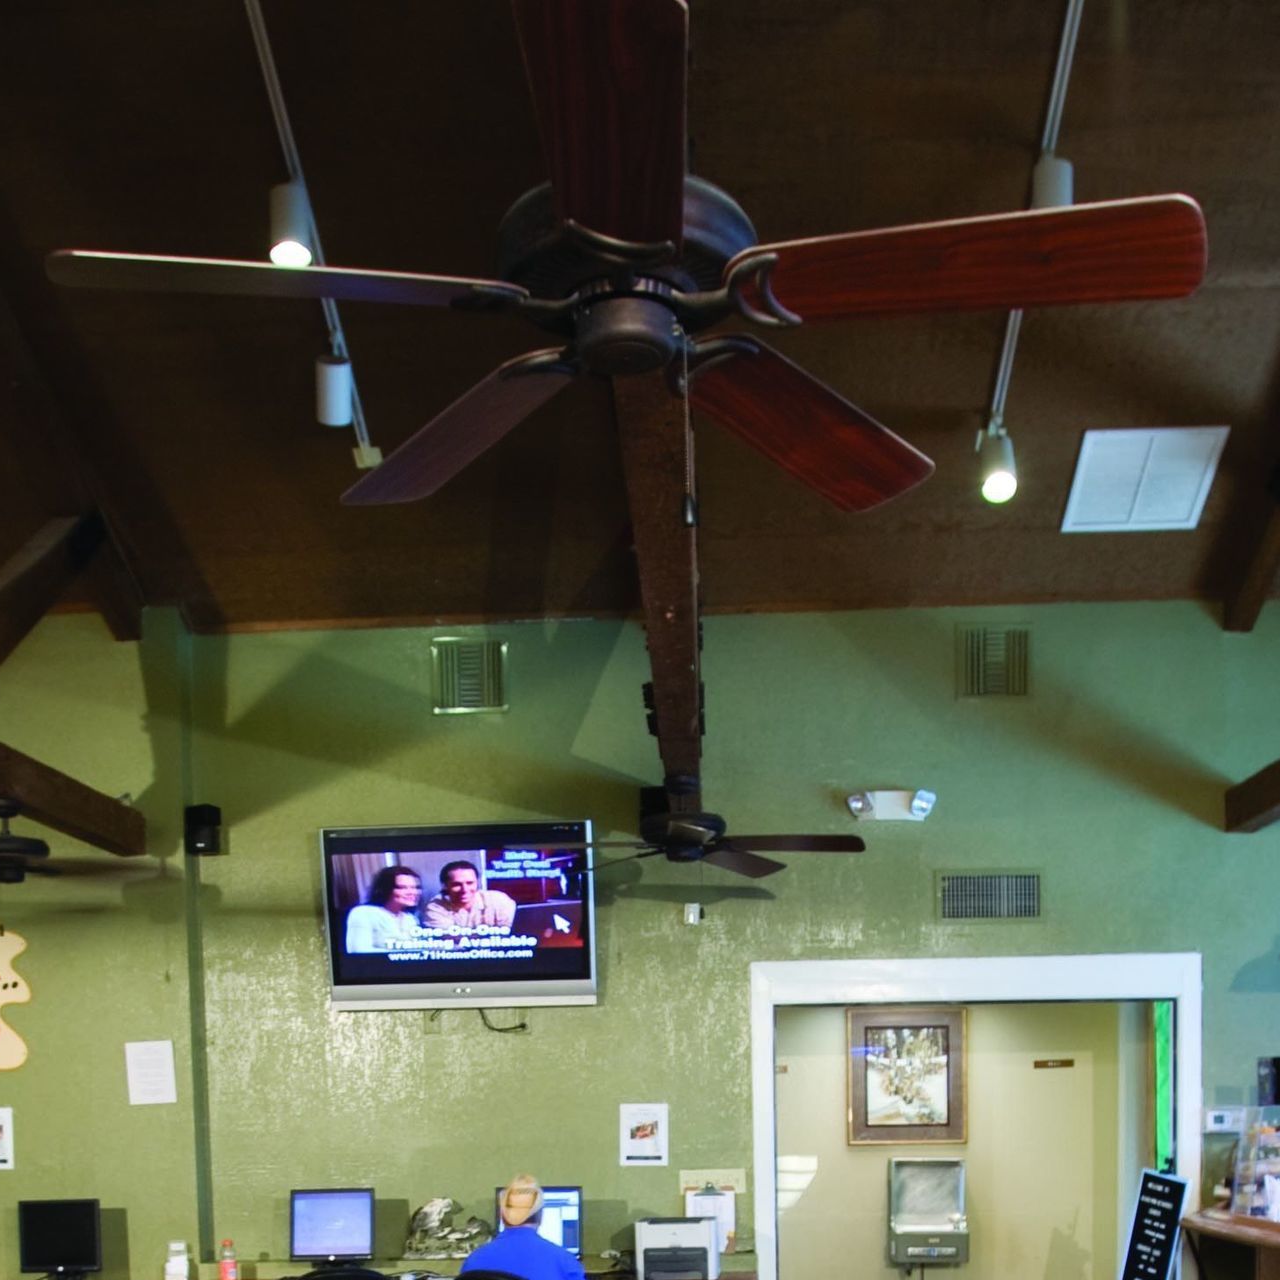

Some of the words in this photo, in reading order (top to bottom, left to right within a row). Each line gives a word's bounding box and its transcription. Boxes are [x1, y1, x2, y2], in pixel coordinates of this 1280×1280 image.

[410, 925, 511, 937] One-On-One
[386, 938, 454, 949] Training
[459, 936, 538, 947] Available
